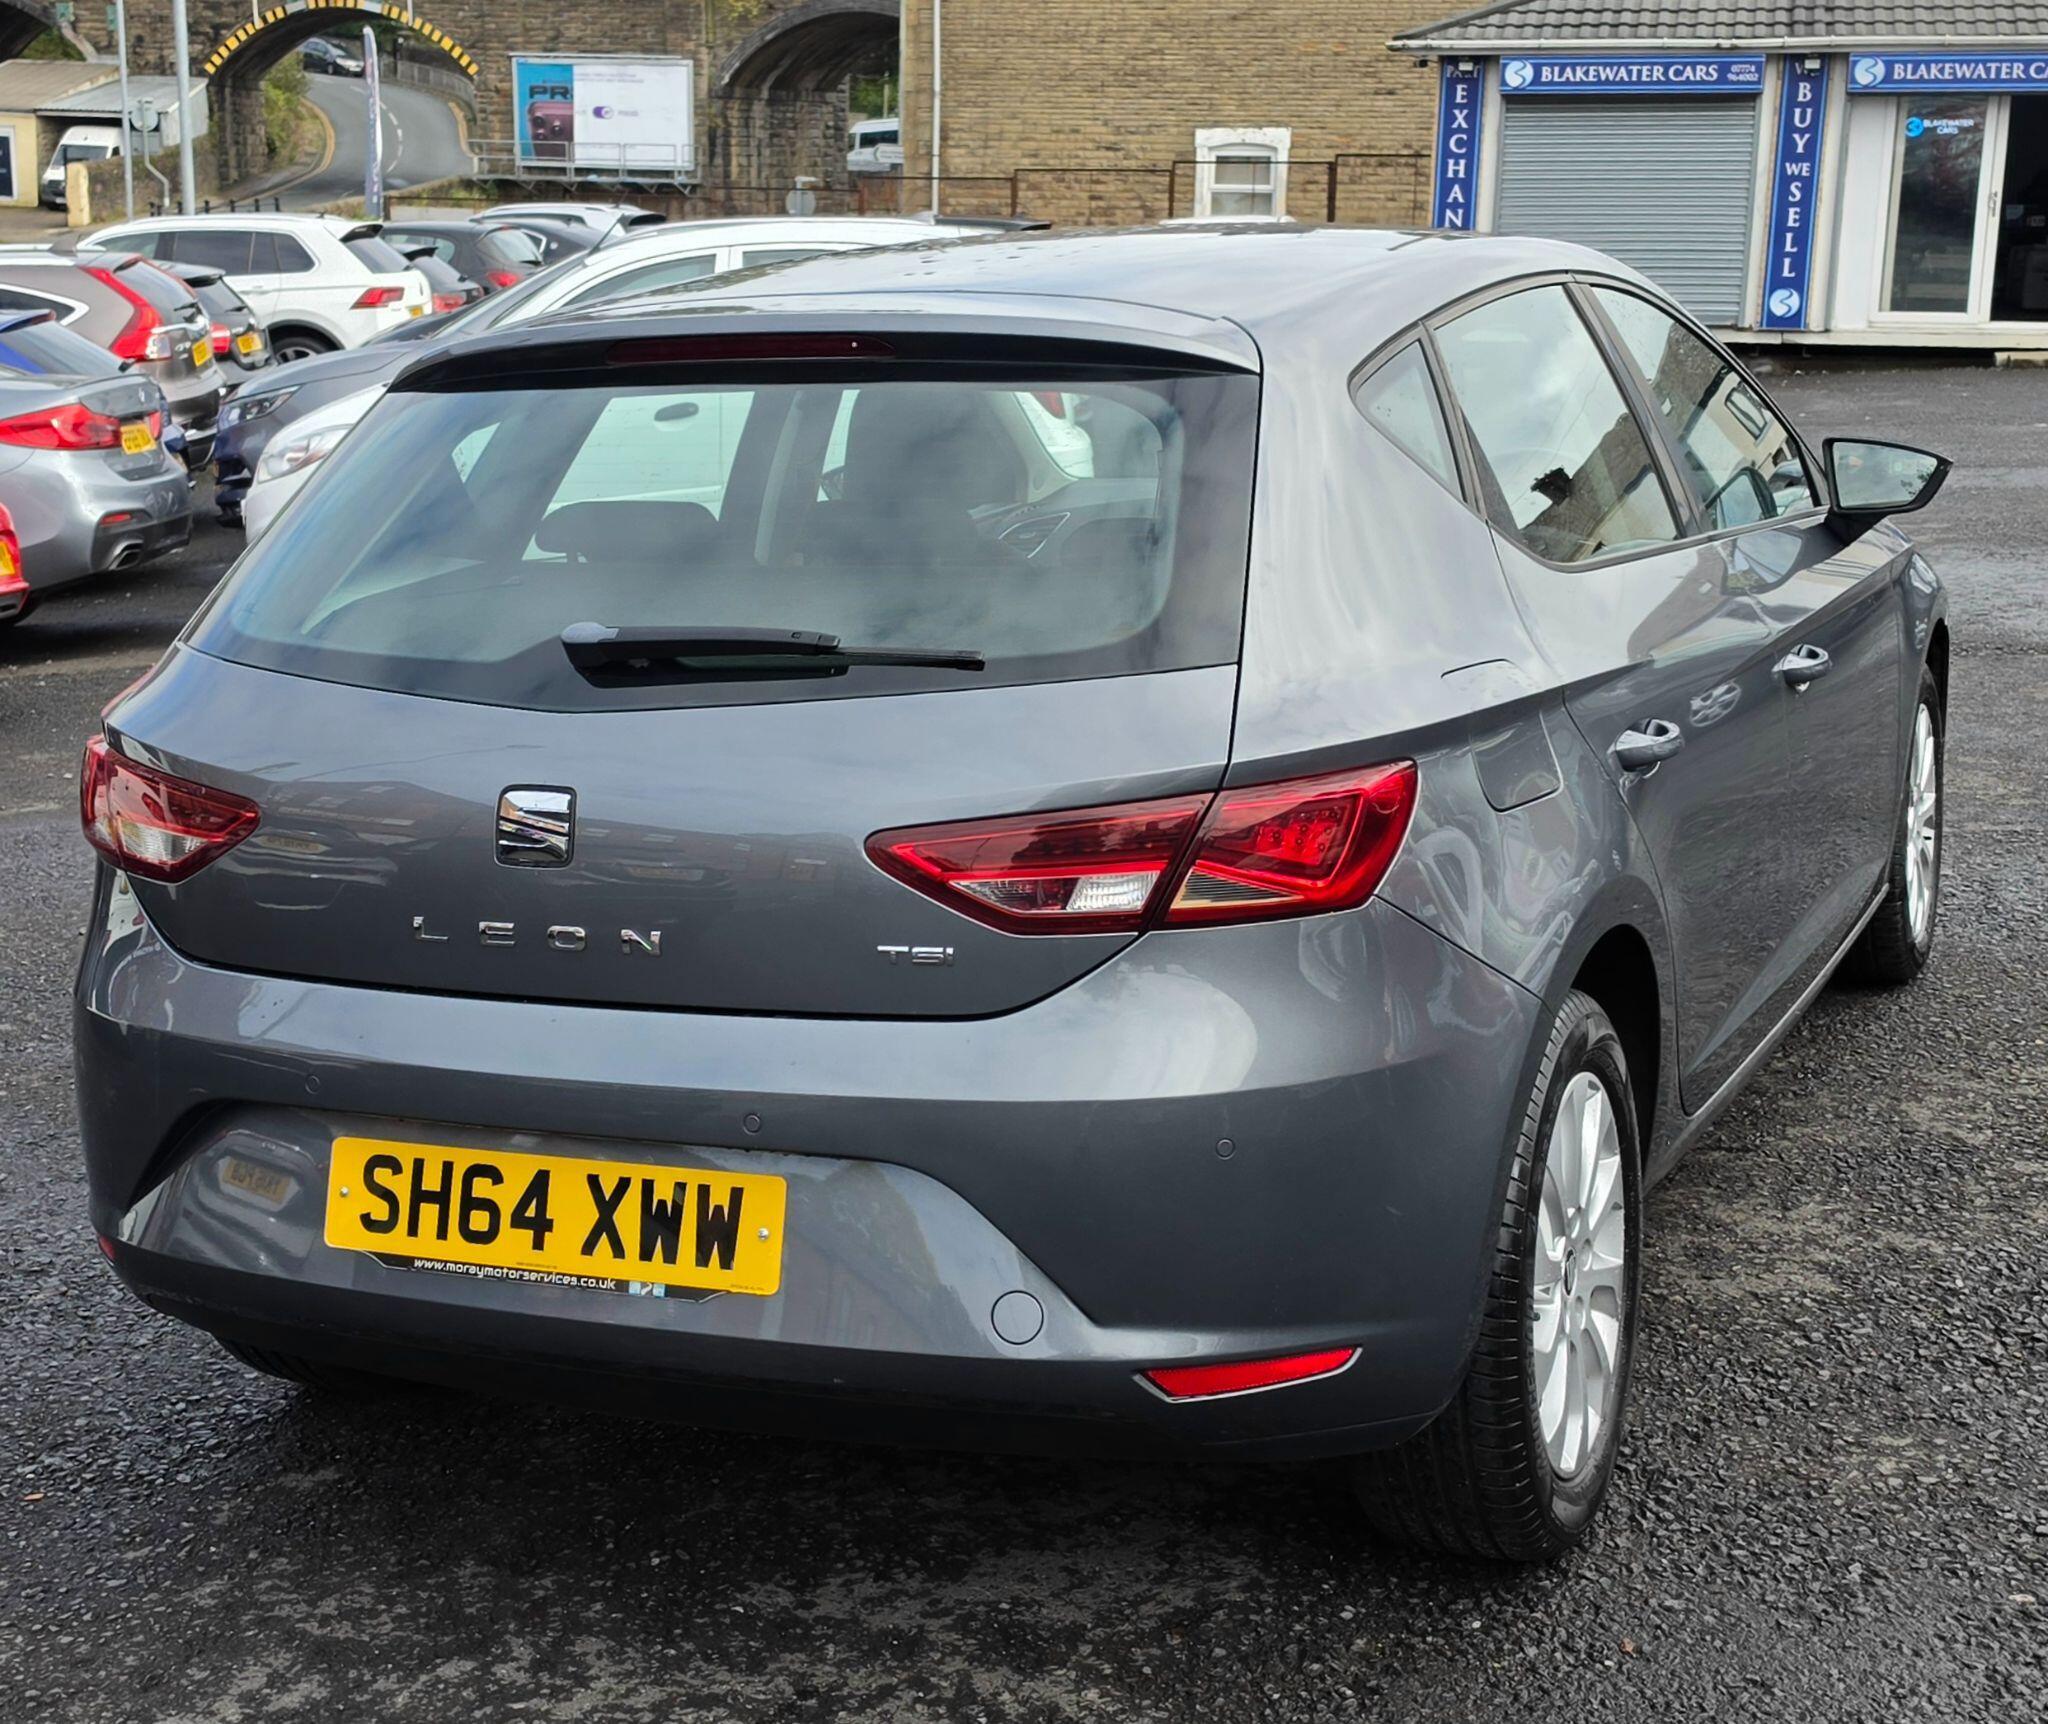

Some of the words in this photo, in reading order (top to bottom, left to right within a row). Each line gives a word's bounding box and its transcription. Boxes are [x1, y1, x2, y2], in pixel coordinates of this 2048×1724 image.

[1446, 65, 1482, 79] PAT
[1540, 65, 1666, 83] BLAKEWATER
[1668, 64, 1718, 81] CARS
[1893, 62, 2026, 80] BLAKEWATER
[529, 85, 574, 100] PR
[1793, 82, 1813, 154] BUY
[1785, 162, 1811, 177] WE
[1782, 182, 1802, 278] SELL
[412, 916, 663, 957] LEON
[877, 945, 954, 966] TSI
[359, 1154, 554, 1252] SH64
[580, 1173, 745, 1271] XWW
[413, 1258, 617, 1290] www.moraymotorservices.co.uk
